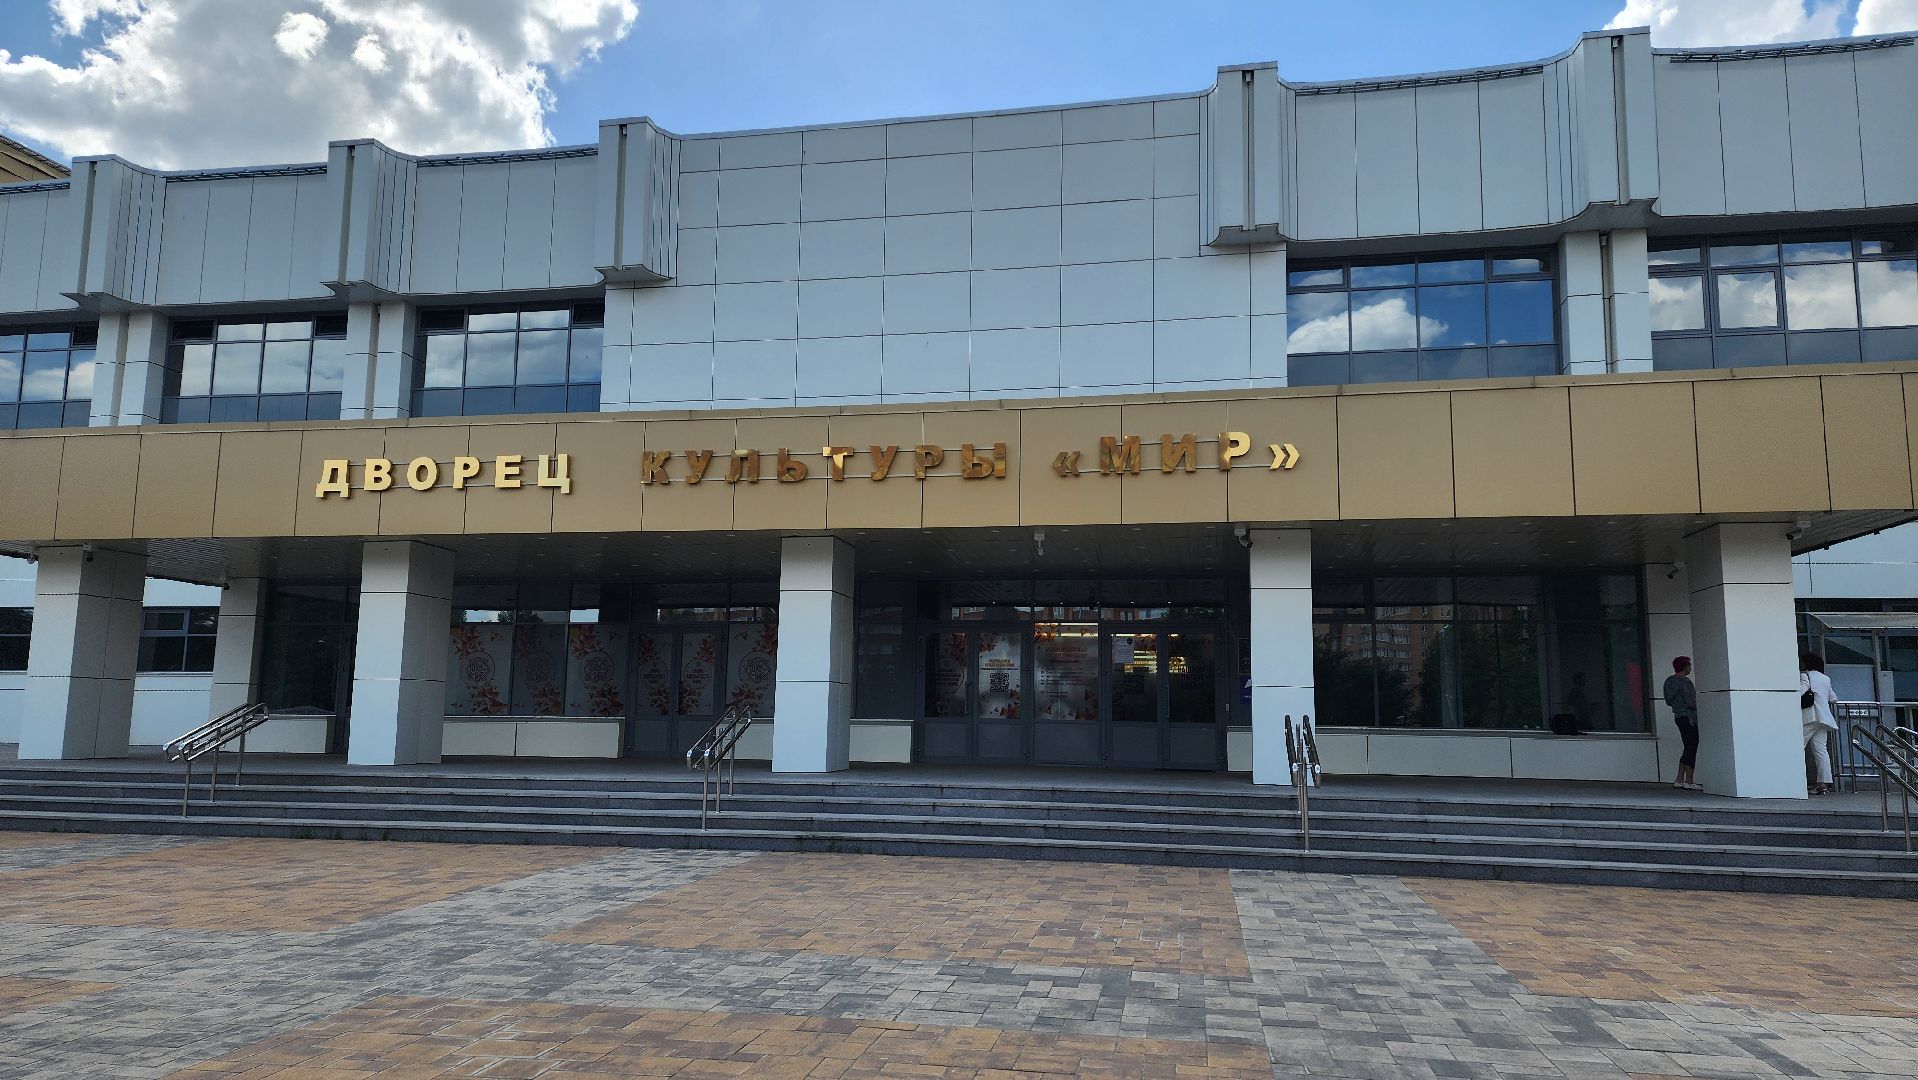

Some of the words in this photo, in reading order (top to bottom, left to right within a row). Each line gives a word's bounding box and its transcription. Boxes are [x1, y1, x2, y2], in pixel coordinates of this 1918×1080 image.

[316, 454, 571, 498] ДВОРЕЦ
[641, 443, 1006, 484] КУЛЬТУРЫ
[1054, 431, 1300, 476] «МИР»
